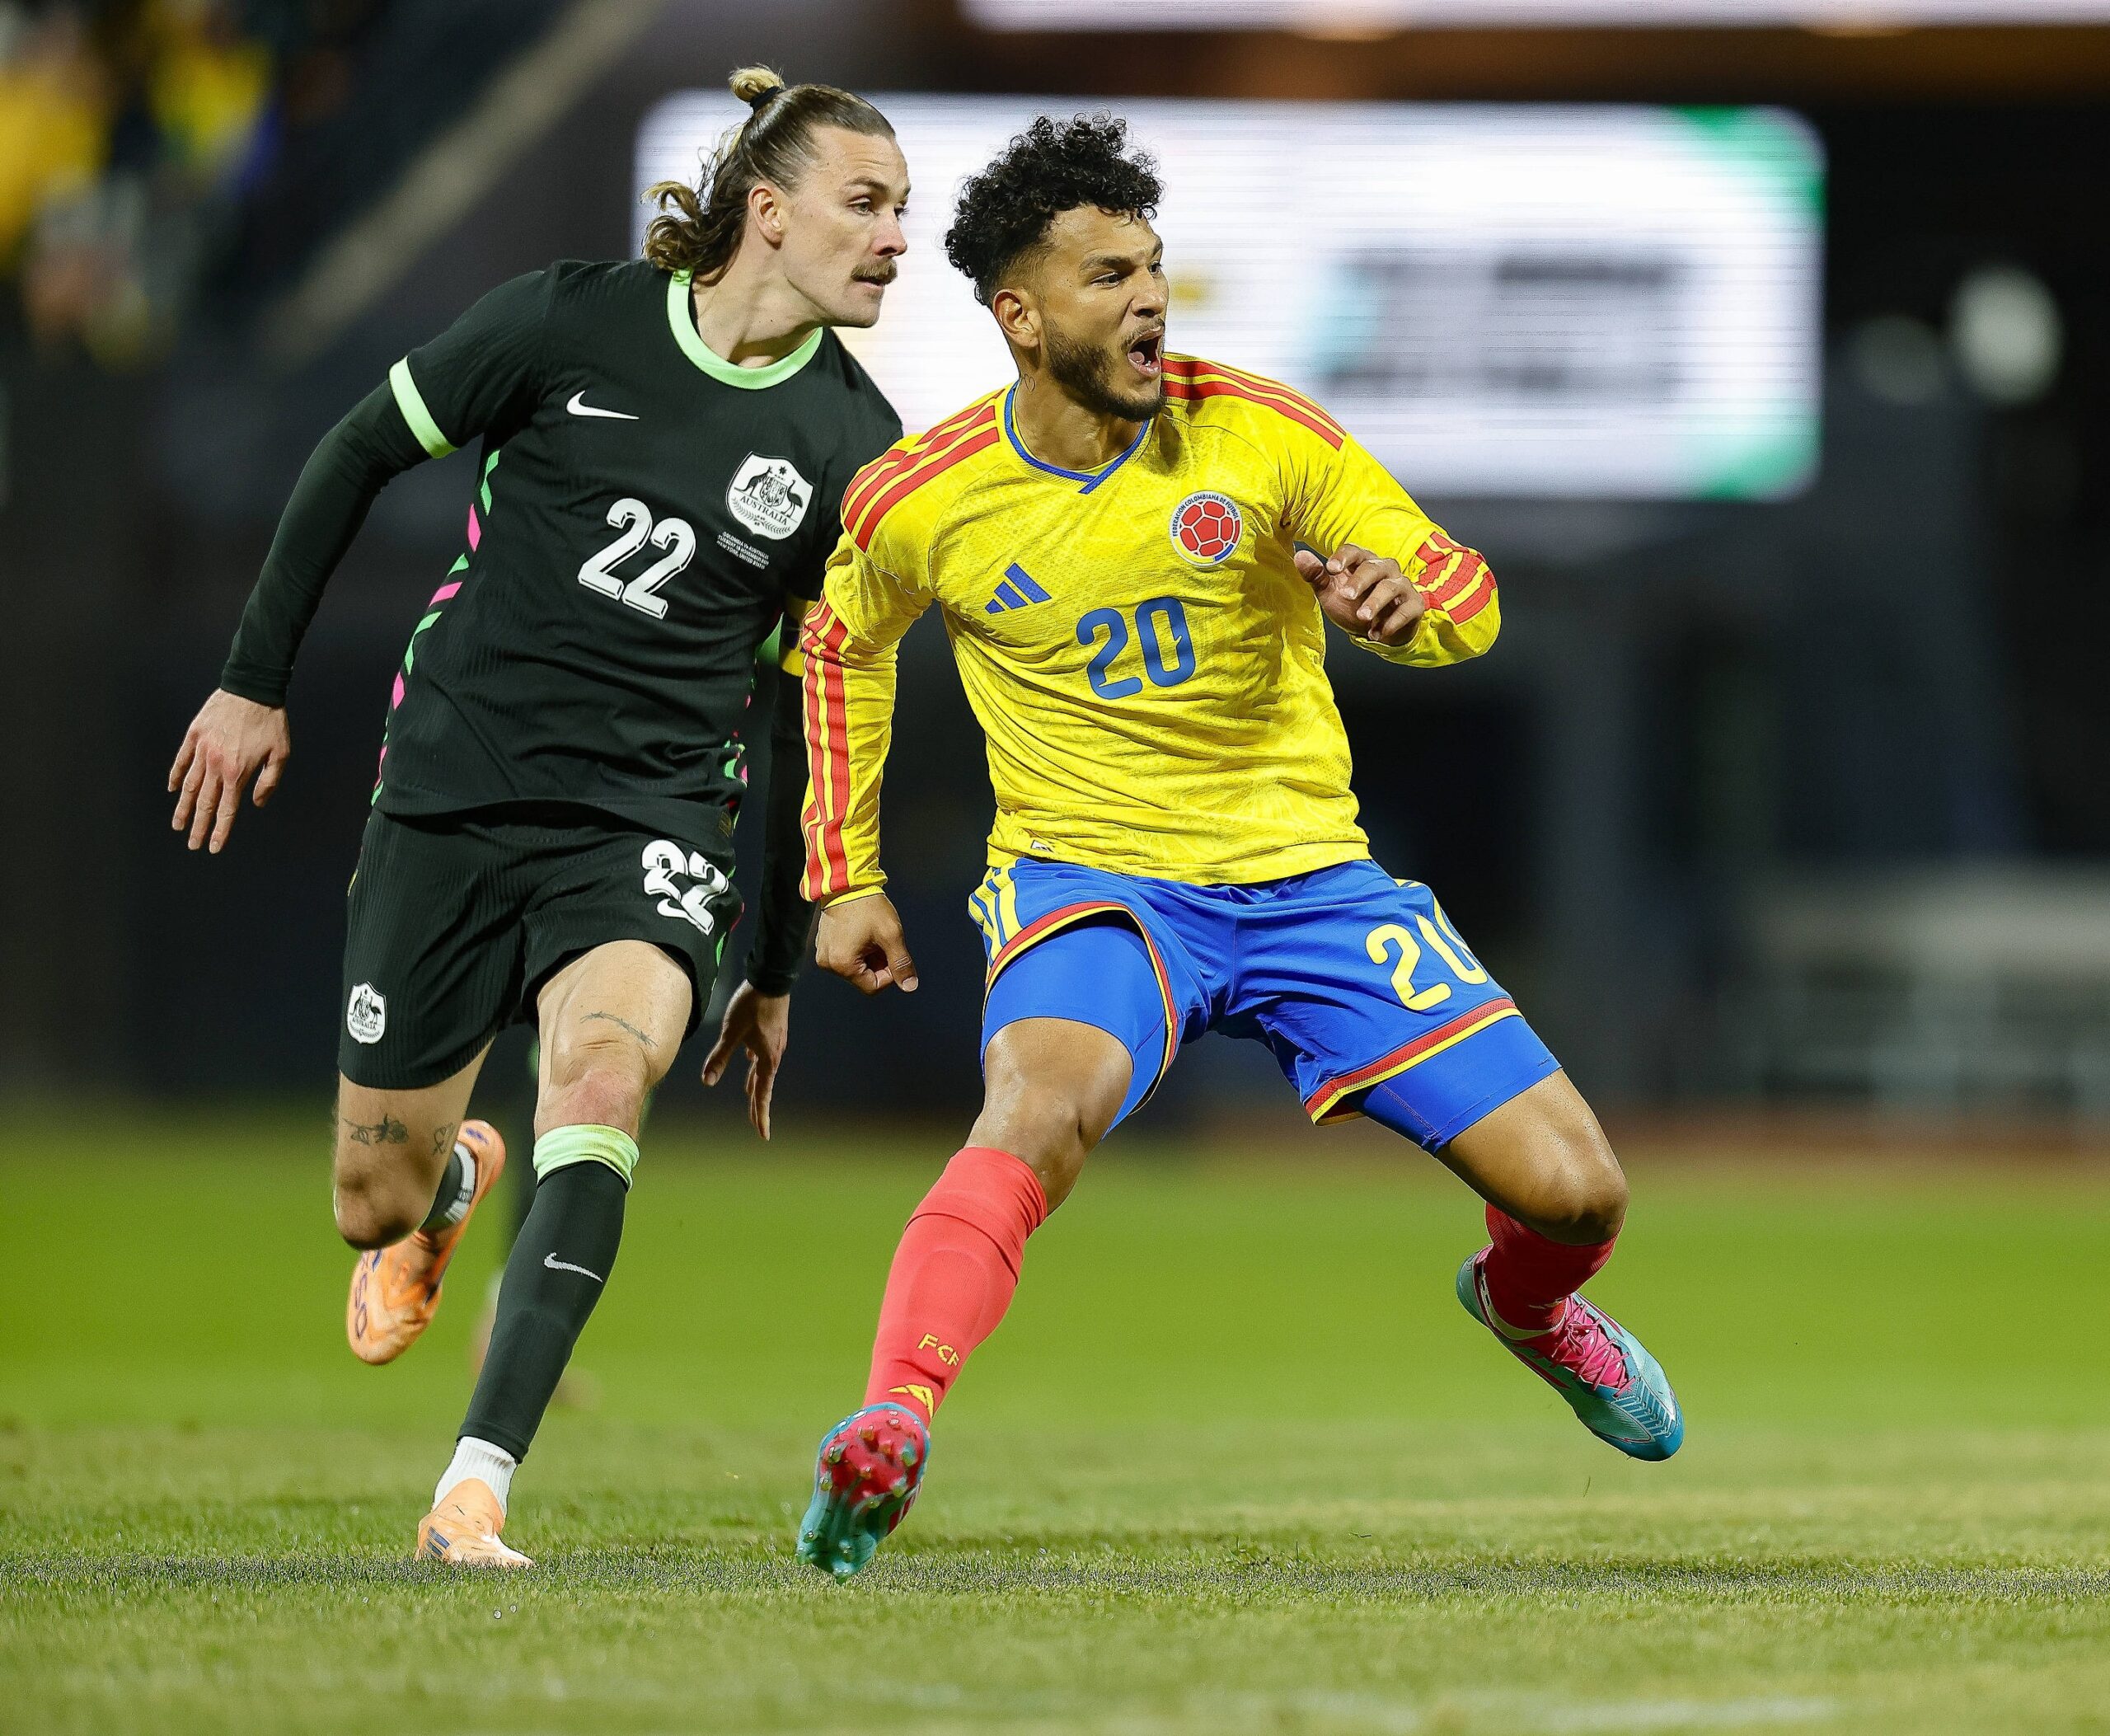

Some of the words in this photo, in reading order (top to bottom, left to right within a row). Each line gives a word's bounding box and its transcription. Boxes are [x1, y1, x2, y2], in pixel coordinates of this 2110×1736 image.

[577, 497, 696, 620] 22
[739, 495, 788, 526] AUSTRALIA
[1076, 596, 1197, 700] 20
[1365, 914, 1489, 1011] 20
